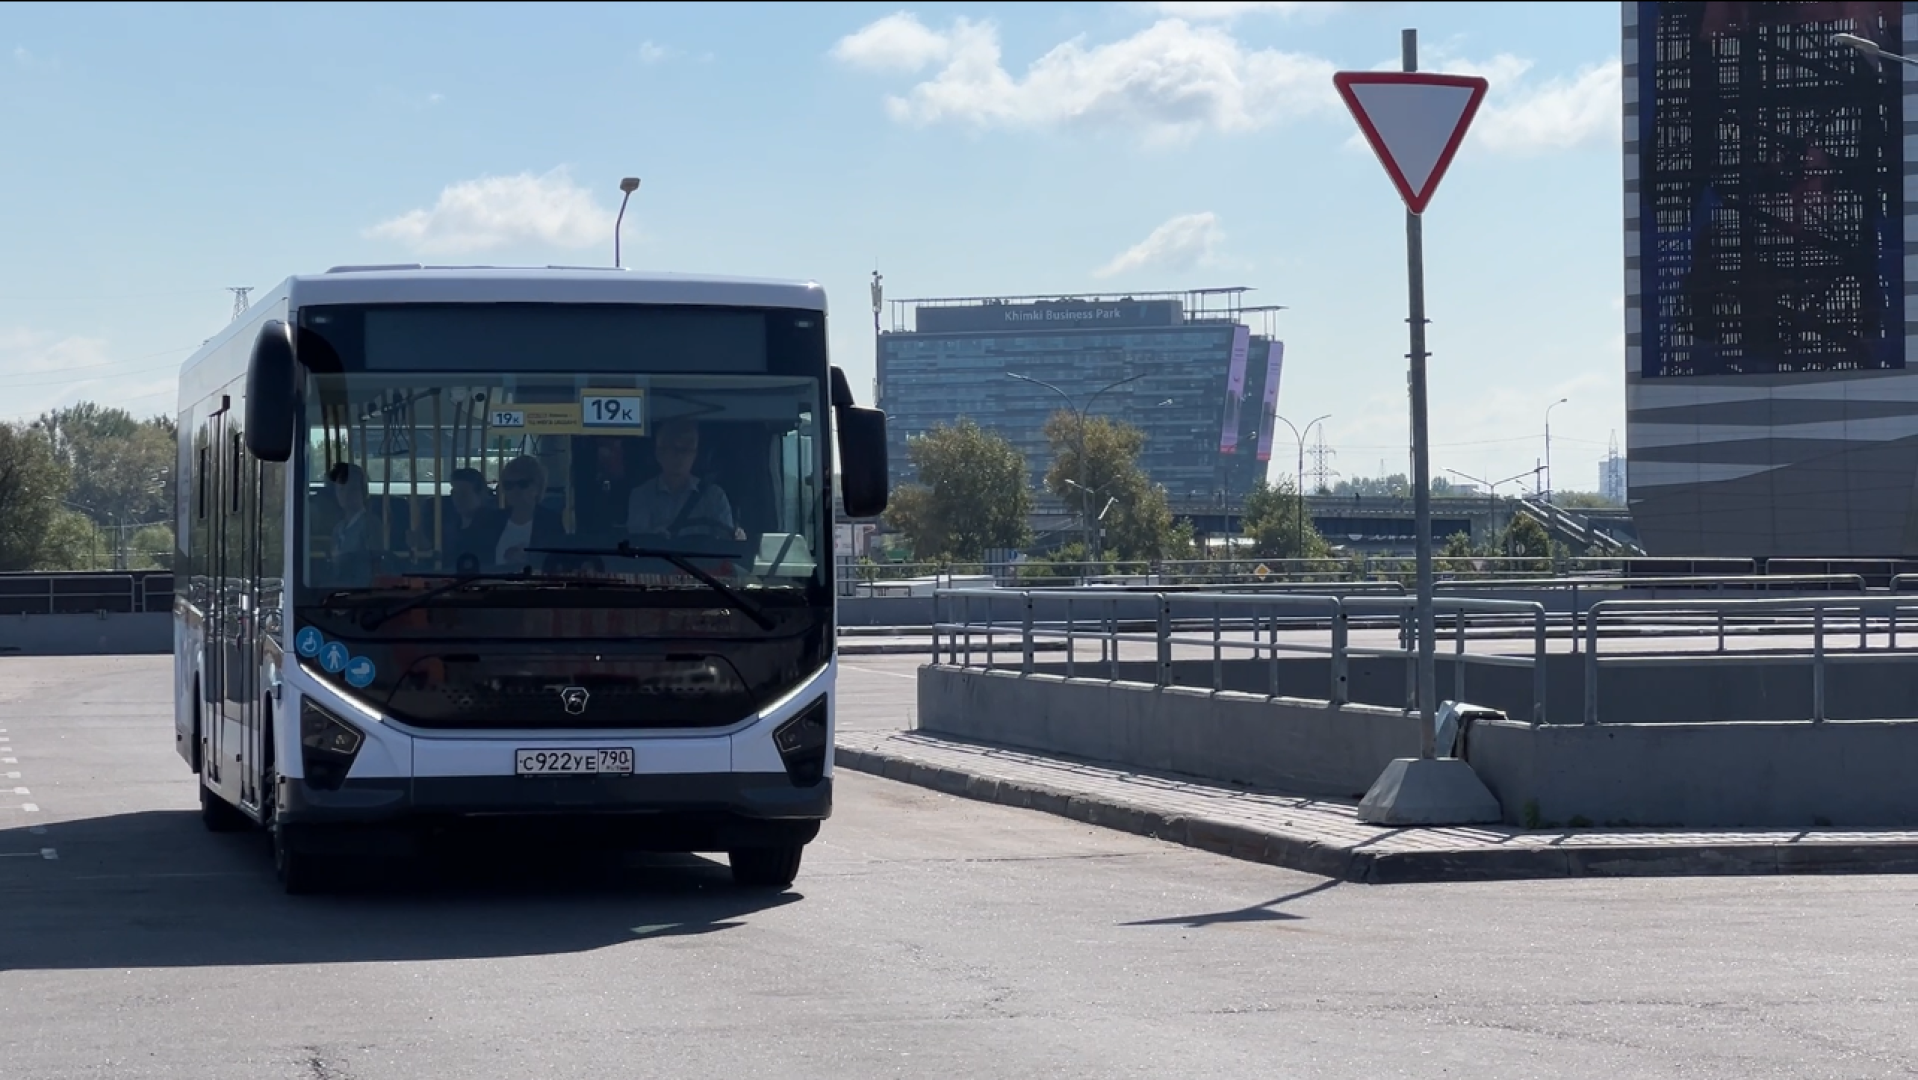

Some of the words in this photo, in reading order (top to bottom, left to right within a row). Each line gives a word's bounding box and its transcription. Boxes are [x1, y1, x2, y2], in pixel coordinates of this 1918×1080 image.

[1004, 310, 1043, 321] Khimki
[1046, 309, 1093, 320] Business
[1096, 307, 1121, 319] Park
[522, 752, 597, 771] С922УЕ
[599, 750, 628, 766] 790
